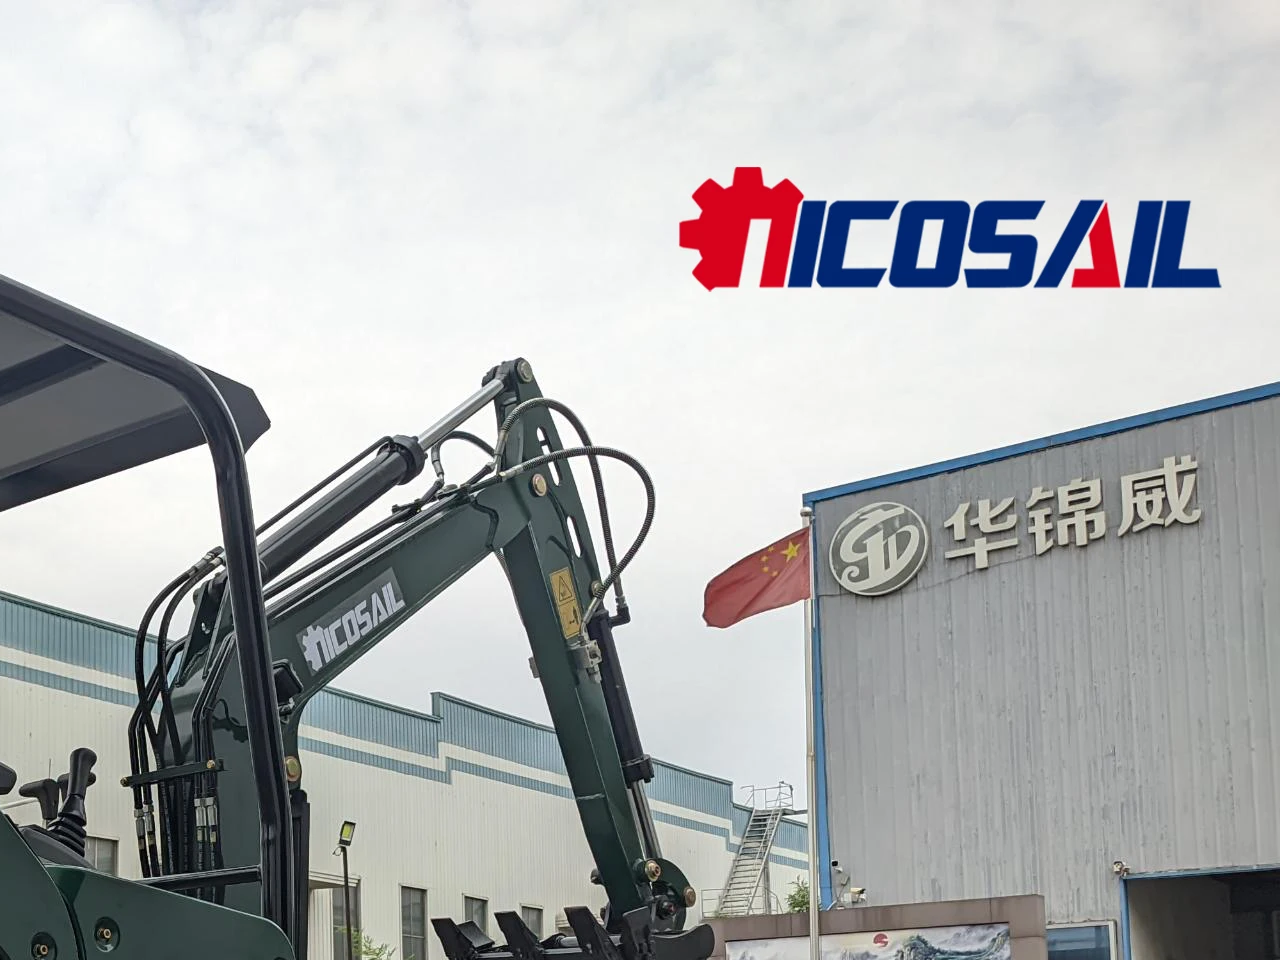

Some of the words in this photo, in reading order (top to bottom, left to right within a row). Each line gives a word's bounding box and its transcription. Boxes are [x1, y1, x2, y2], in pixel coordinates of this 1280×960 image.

[943, 454, 1202, 570] 华锦威
[302, 581, 406, 672] NICOSAIL
